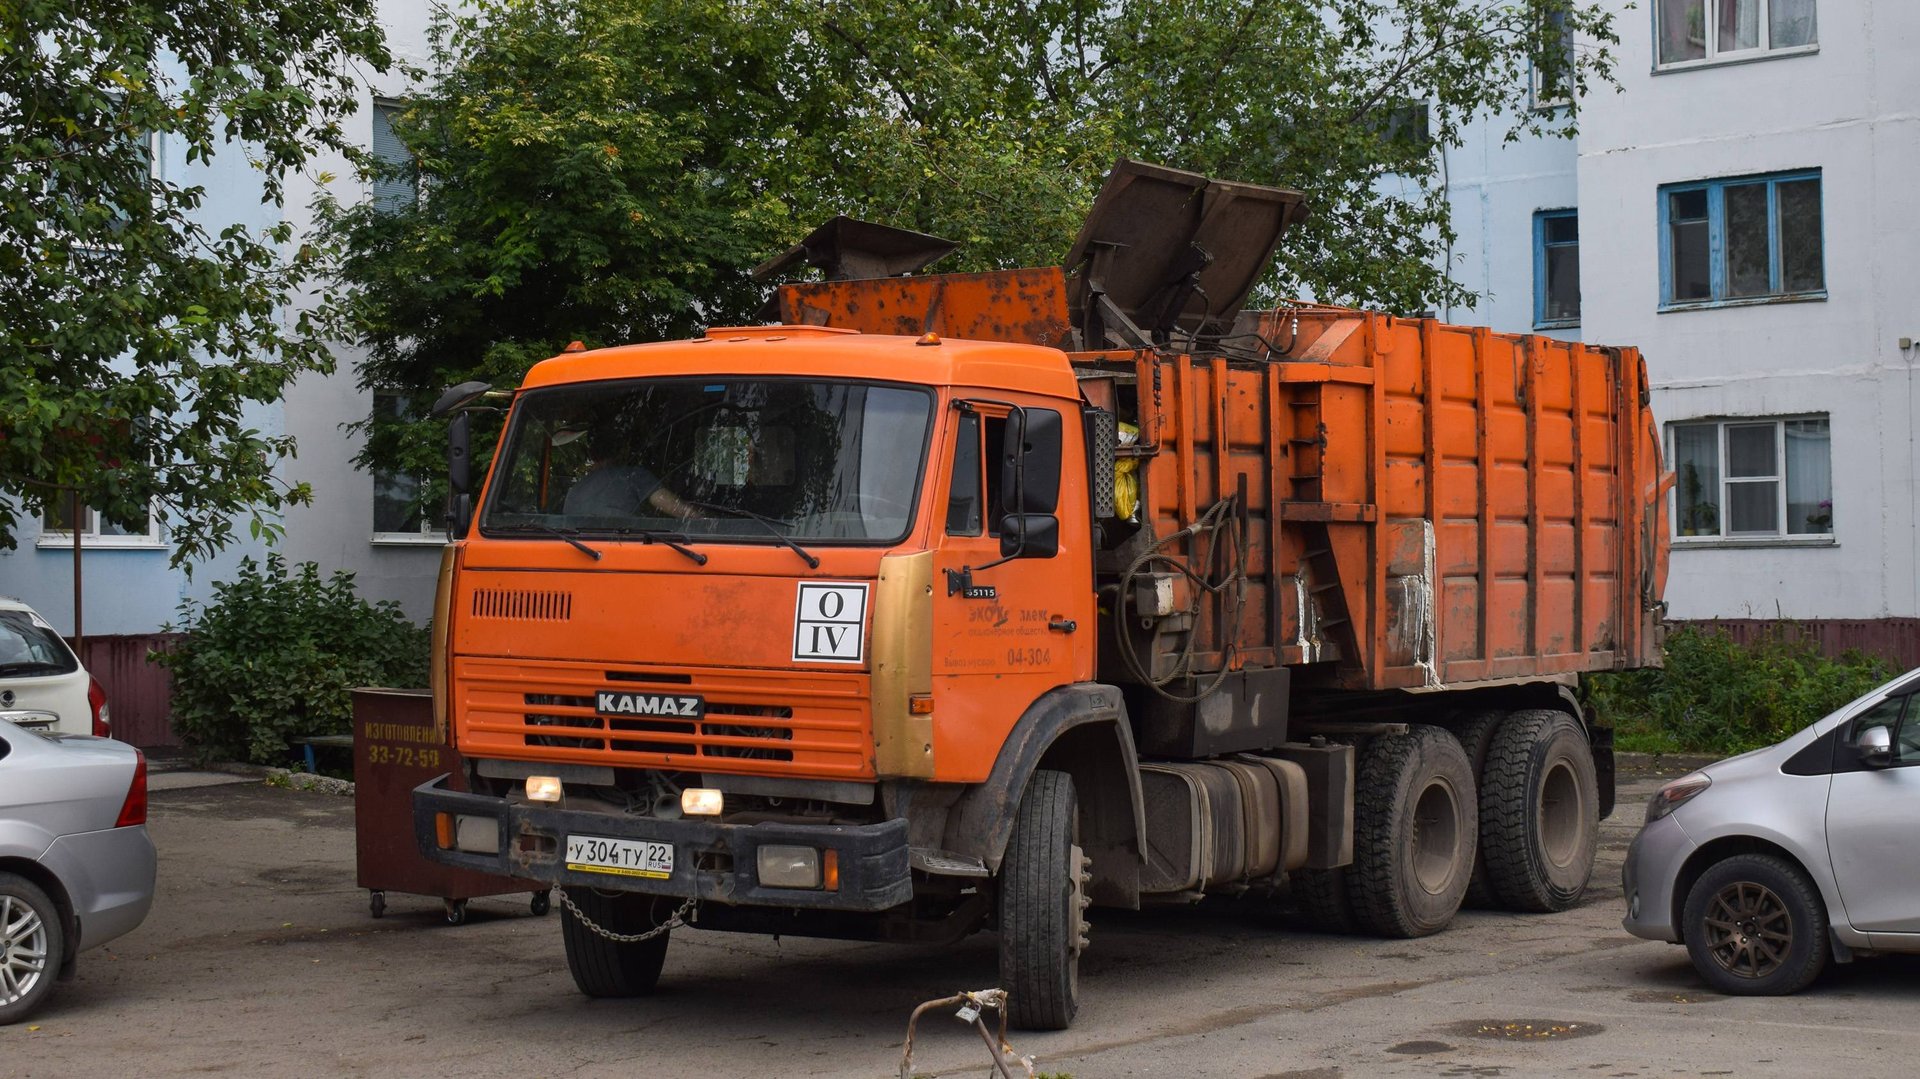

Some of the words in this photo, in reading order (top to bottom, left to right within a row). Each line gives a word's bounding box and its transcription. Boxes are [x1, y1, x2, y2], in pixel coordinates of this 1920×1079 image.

[810, 626, 848, 654] IV
[598, 693, 698, 716] KAMAZ
[649, 845, 666, 862] 22
